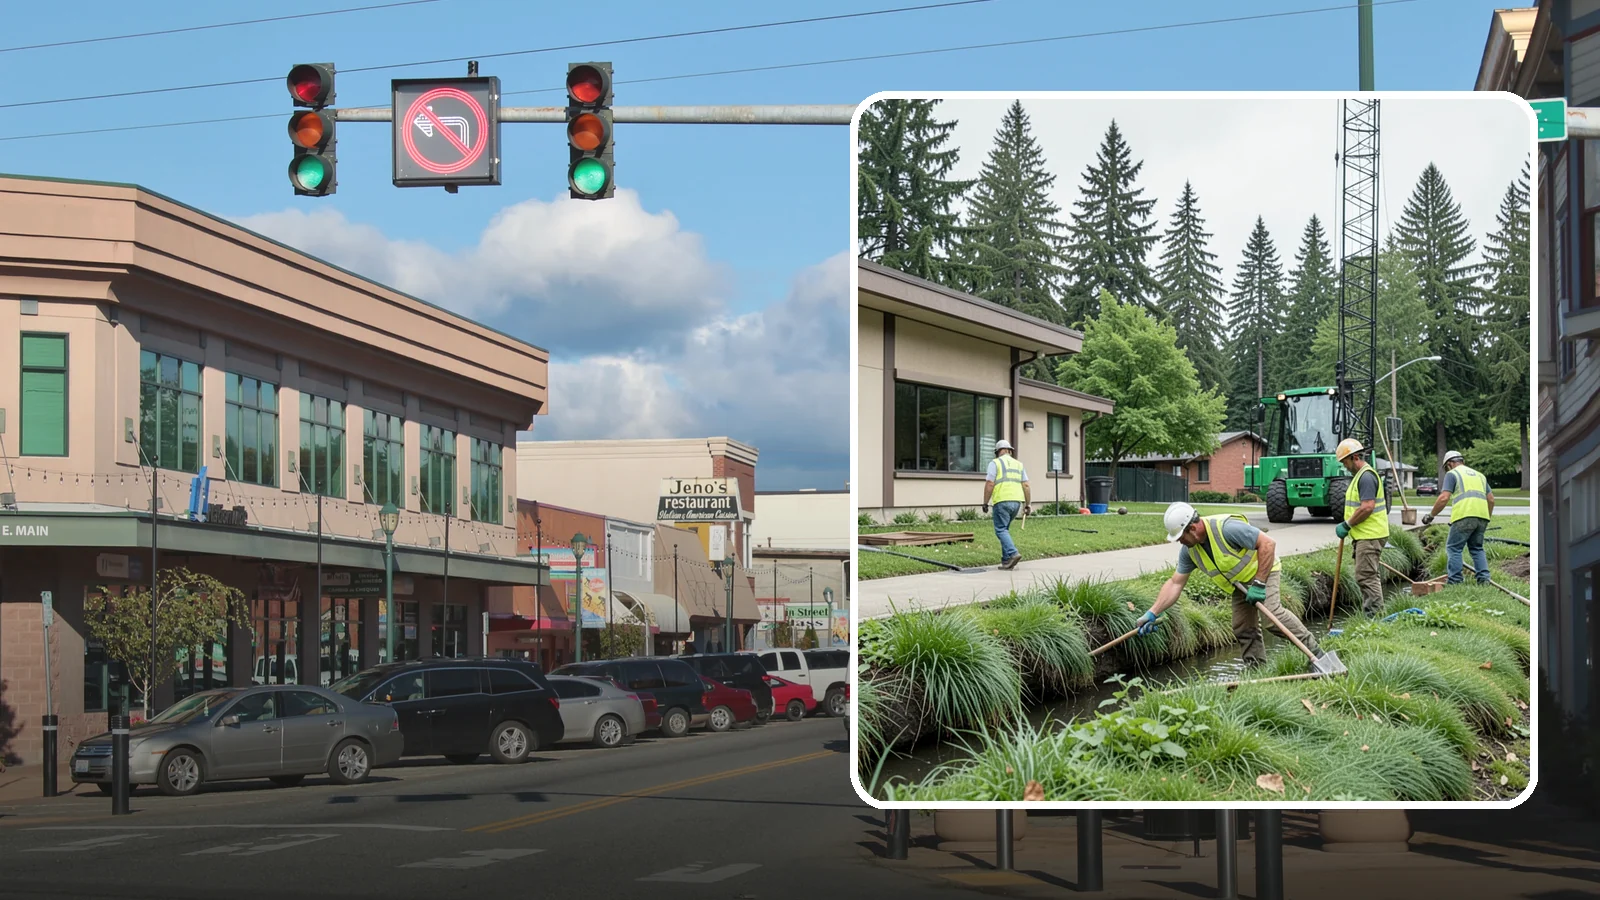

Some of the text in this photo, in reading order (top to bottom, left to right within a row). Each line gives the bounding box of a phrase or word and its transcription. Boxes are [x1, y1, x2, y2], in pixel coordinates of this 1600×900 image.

[670, 479, 728, 494] Jeno's
[665, 496, 731, 509] restaurant
[658, 510, 682, 519] Italian
[686, 510, 714, 519] American
[715, 509, 738, 519] Cuisine
[2, 525, 49, 536] E. MAIN
[797, 607, 828, 617] Street
[791, 619, 823, 627] lass
